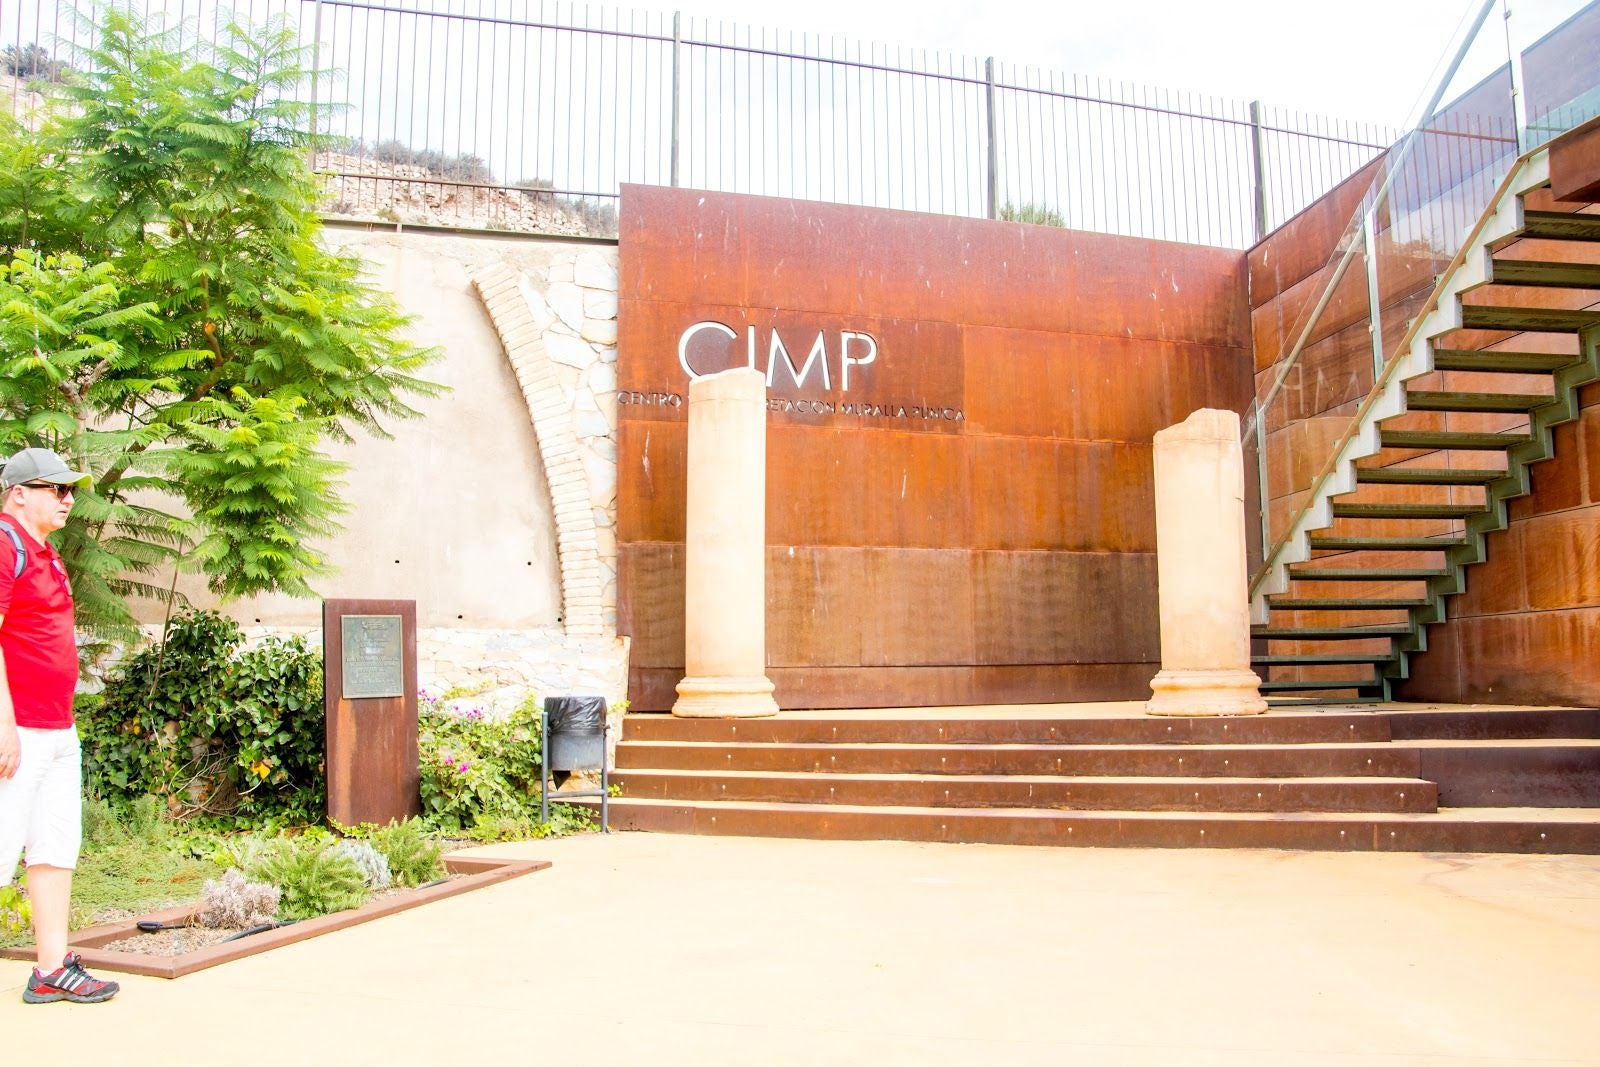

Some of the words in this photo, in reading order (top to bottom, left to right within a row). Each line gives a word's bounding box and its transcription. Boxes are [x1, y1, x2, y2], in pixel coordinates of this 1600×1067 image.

[678, 320, 878, 391] CIMP
[617, 390, 682, 409] CENTRO
[841, 402, 908, 418] MURALLA
[912, 406, 966, 421] PUNICA
